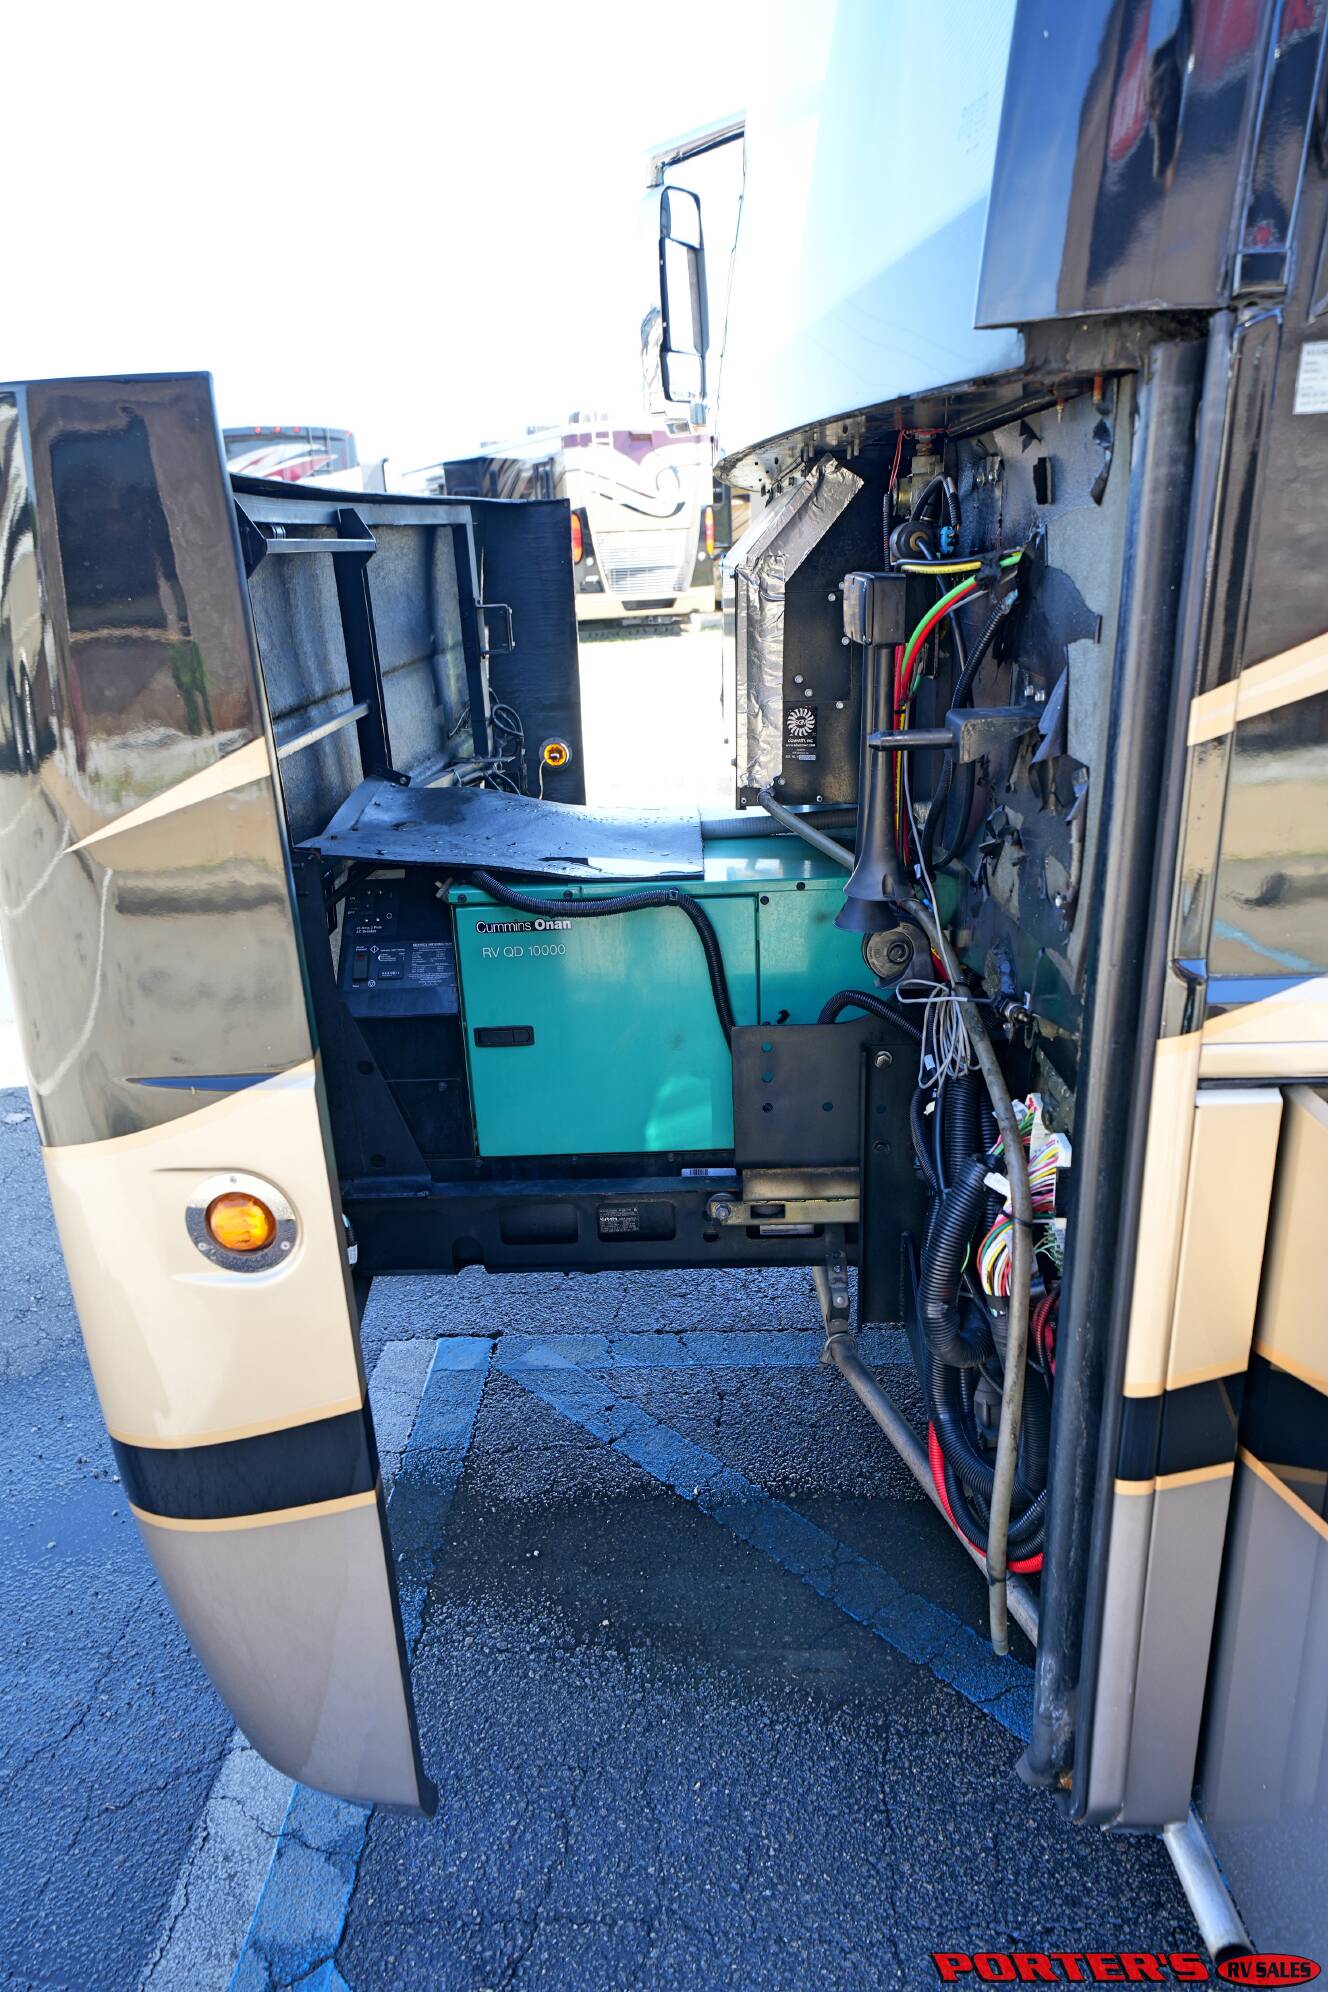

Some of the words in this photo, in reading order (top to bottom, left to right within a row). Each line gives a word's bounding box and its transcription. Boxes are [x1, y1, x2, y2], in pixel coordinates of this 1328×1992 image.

[476, 921, 532, 933] Cummins
[534, 919, 572, 931] Onan
[482, 947, 500, 958] RV
[503, 946, 524, 958] QD
[528, 944, 566, 956] 10000
